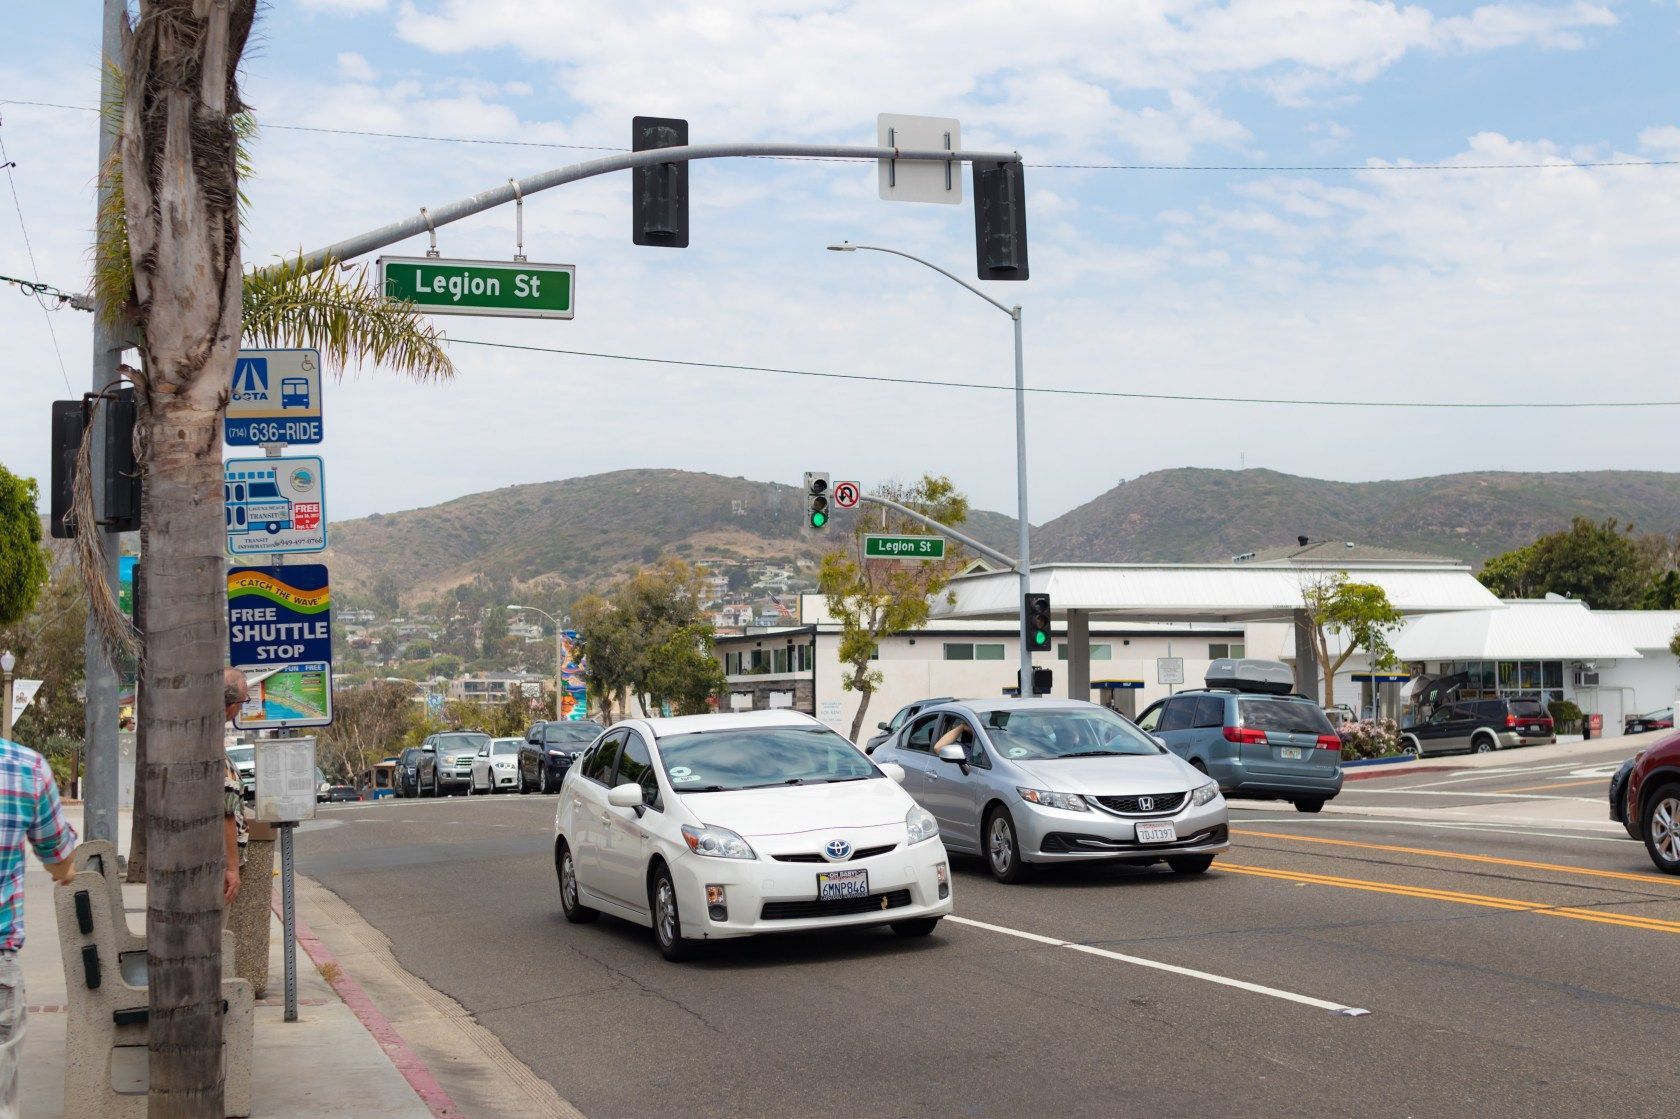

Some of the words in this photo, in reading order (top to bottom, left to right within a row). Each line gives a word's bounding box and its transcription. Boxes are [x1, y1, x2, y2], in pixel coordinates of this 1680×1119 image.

[416, 269, 500, 302] Legion
[514, 273, 541, 298] St
[228, 427, 247, 438] (714)
[249, 422, 320, 441] 636-RIDE
[295, 504, 319, 512] FREE
[249, 512, 279, 520] TRANSIT
[878, 540, 914, 554] Legion
[919, 541, 932, 552] St
[275, 587, 290, 600] THE
[231, 607, 277, 622] FREE
[231, 621, 328, 643] SHUTTLE
[256, 644, 305, 660] STOP
[822, 881, 866, 896] 6MNP846
